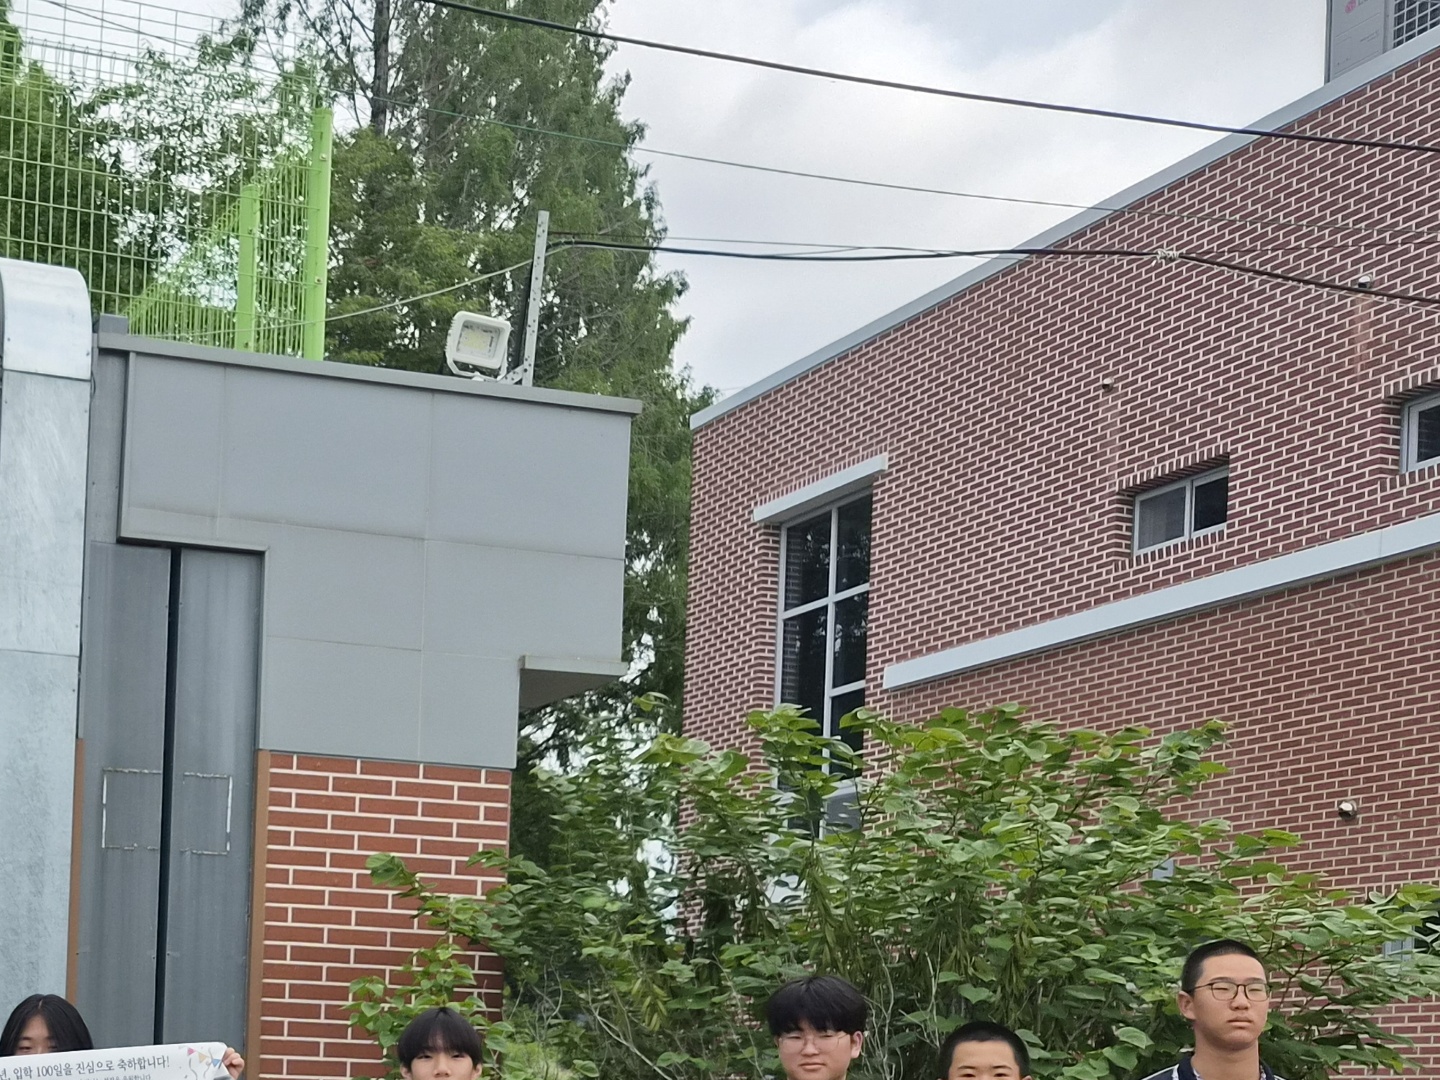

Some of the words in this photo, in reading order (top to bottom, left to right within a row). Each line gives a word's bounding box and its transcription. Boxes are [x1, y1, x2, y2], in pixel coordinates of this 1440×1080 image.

[12, 1065, 32, 1080] 입학
[36, 1062, 72, 1077] 100일을
[76, 1060, 114, 1074] 진심으로
[117, 1055, 169, 1071] 축하합니다!
